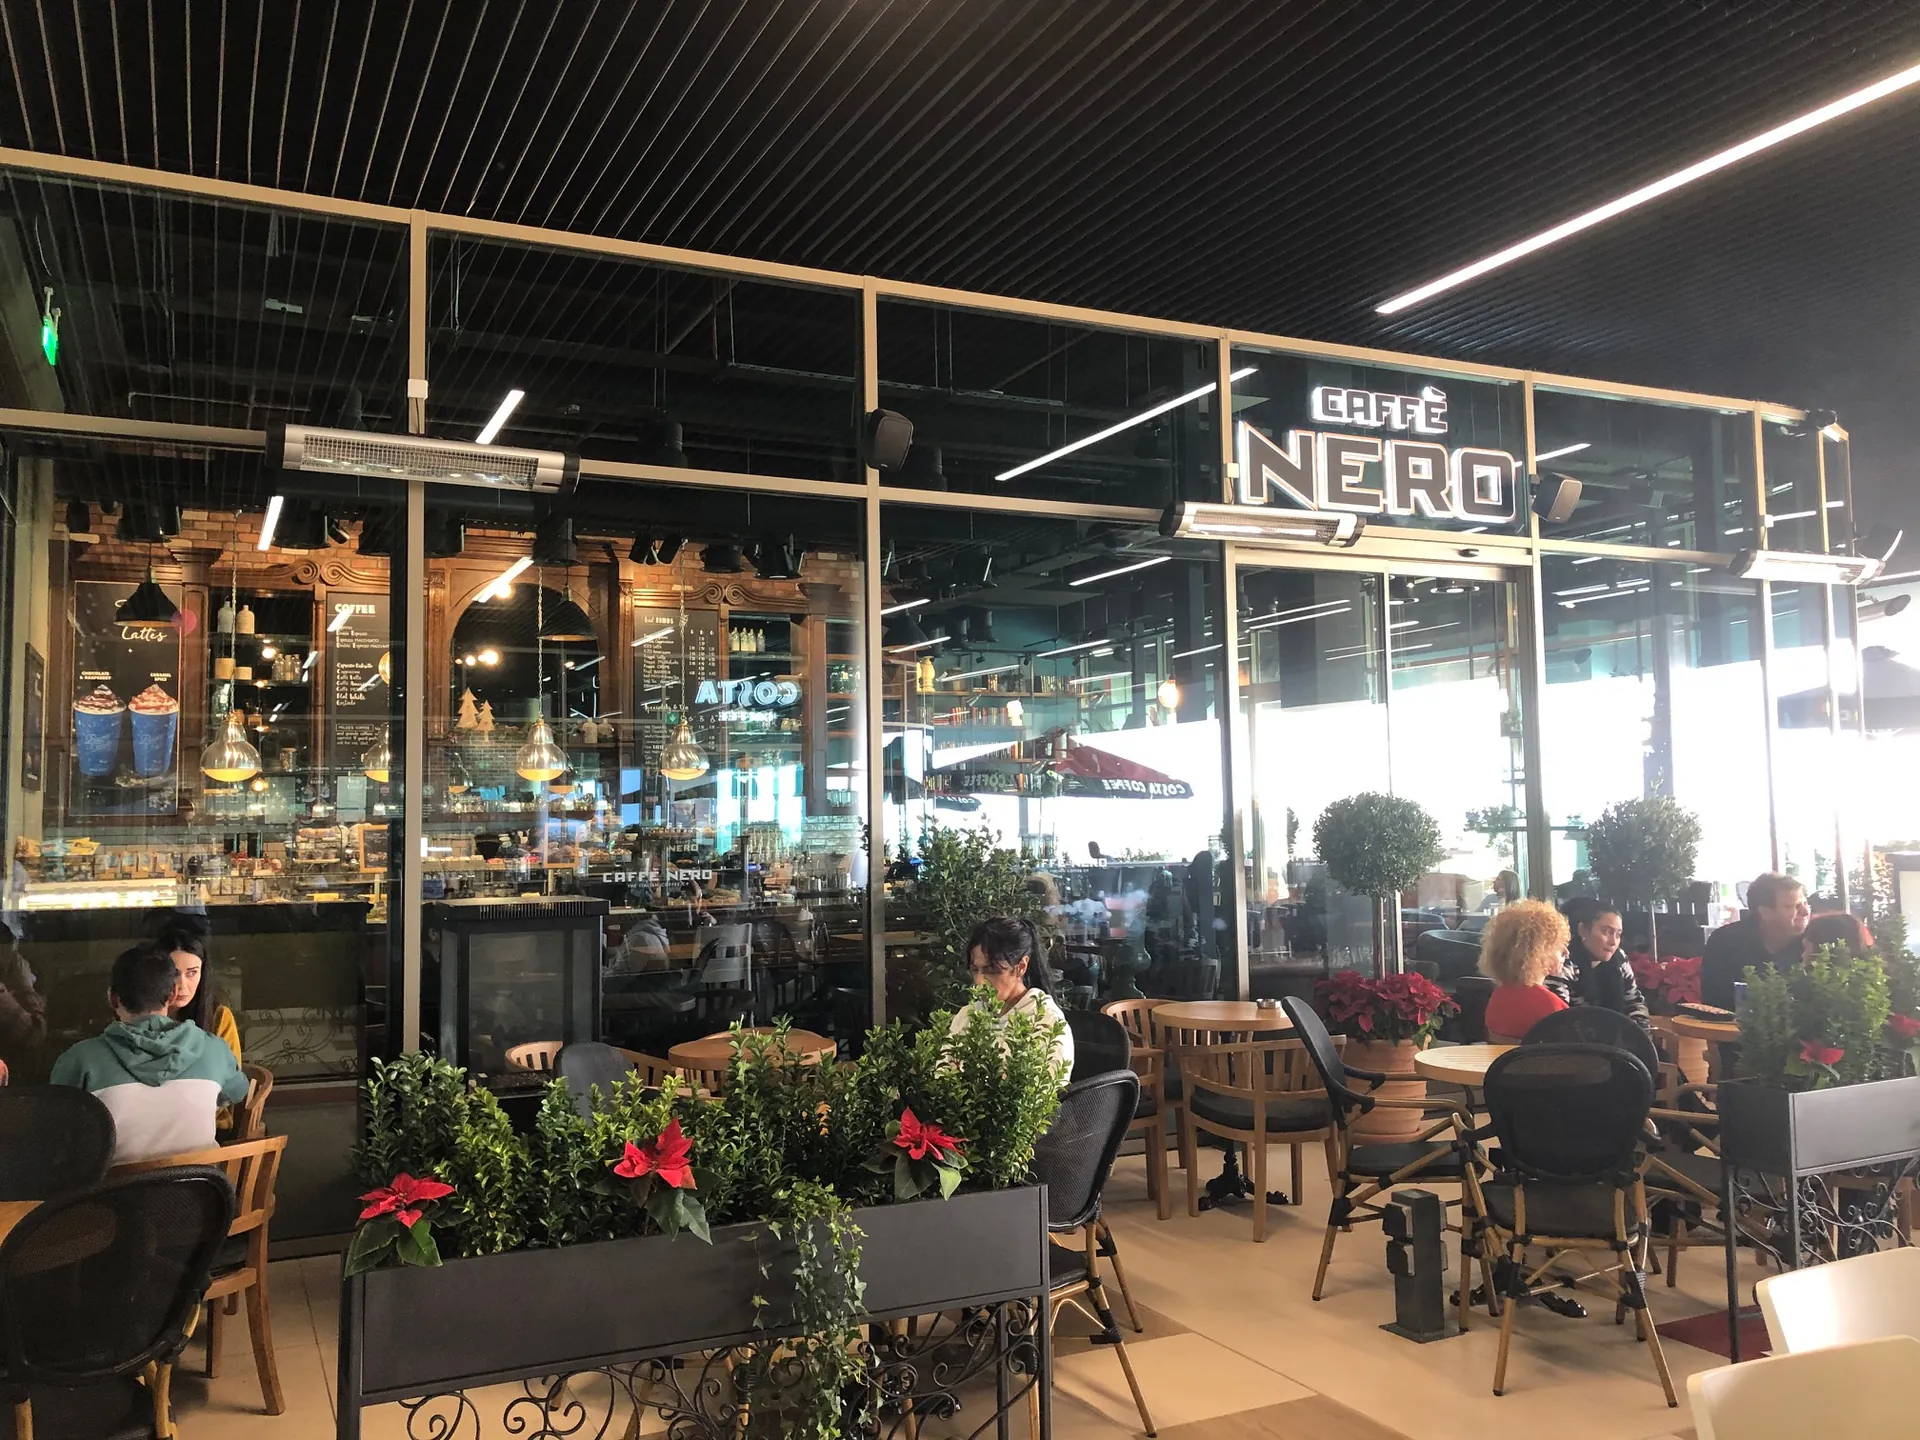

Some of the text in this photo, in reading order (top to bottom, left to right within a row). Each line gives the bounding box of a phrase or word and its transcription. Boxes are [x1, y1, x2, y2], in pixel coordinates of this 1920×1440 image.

[1313, 386, 1447, 434] CAFFÈ
[1238, 420, 1516, 523] NERO
[121, 626, 167, 642] Lattes
[666, 869, 713, 881] NERO
